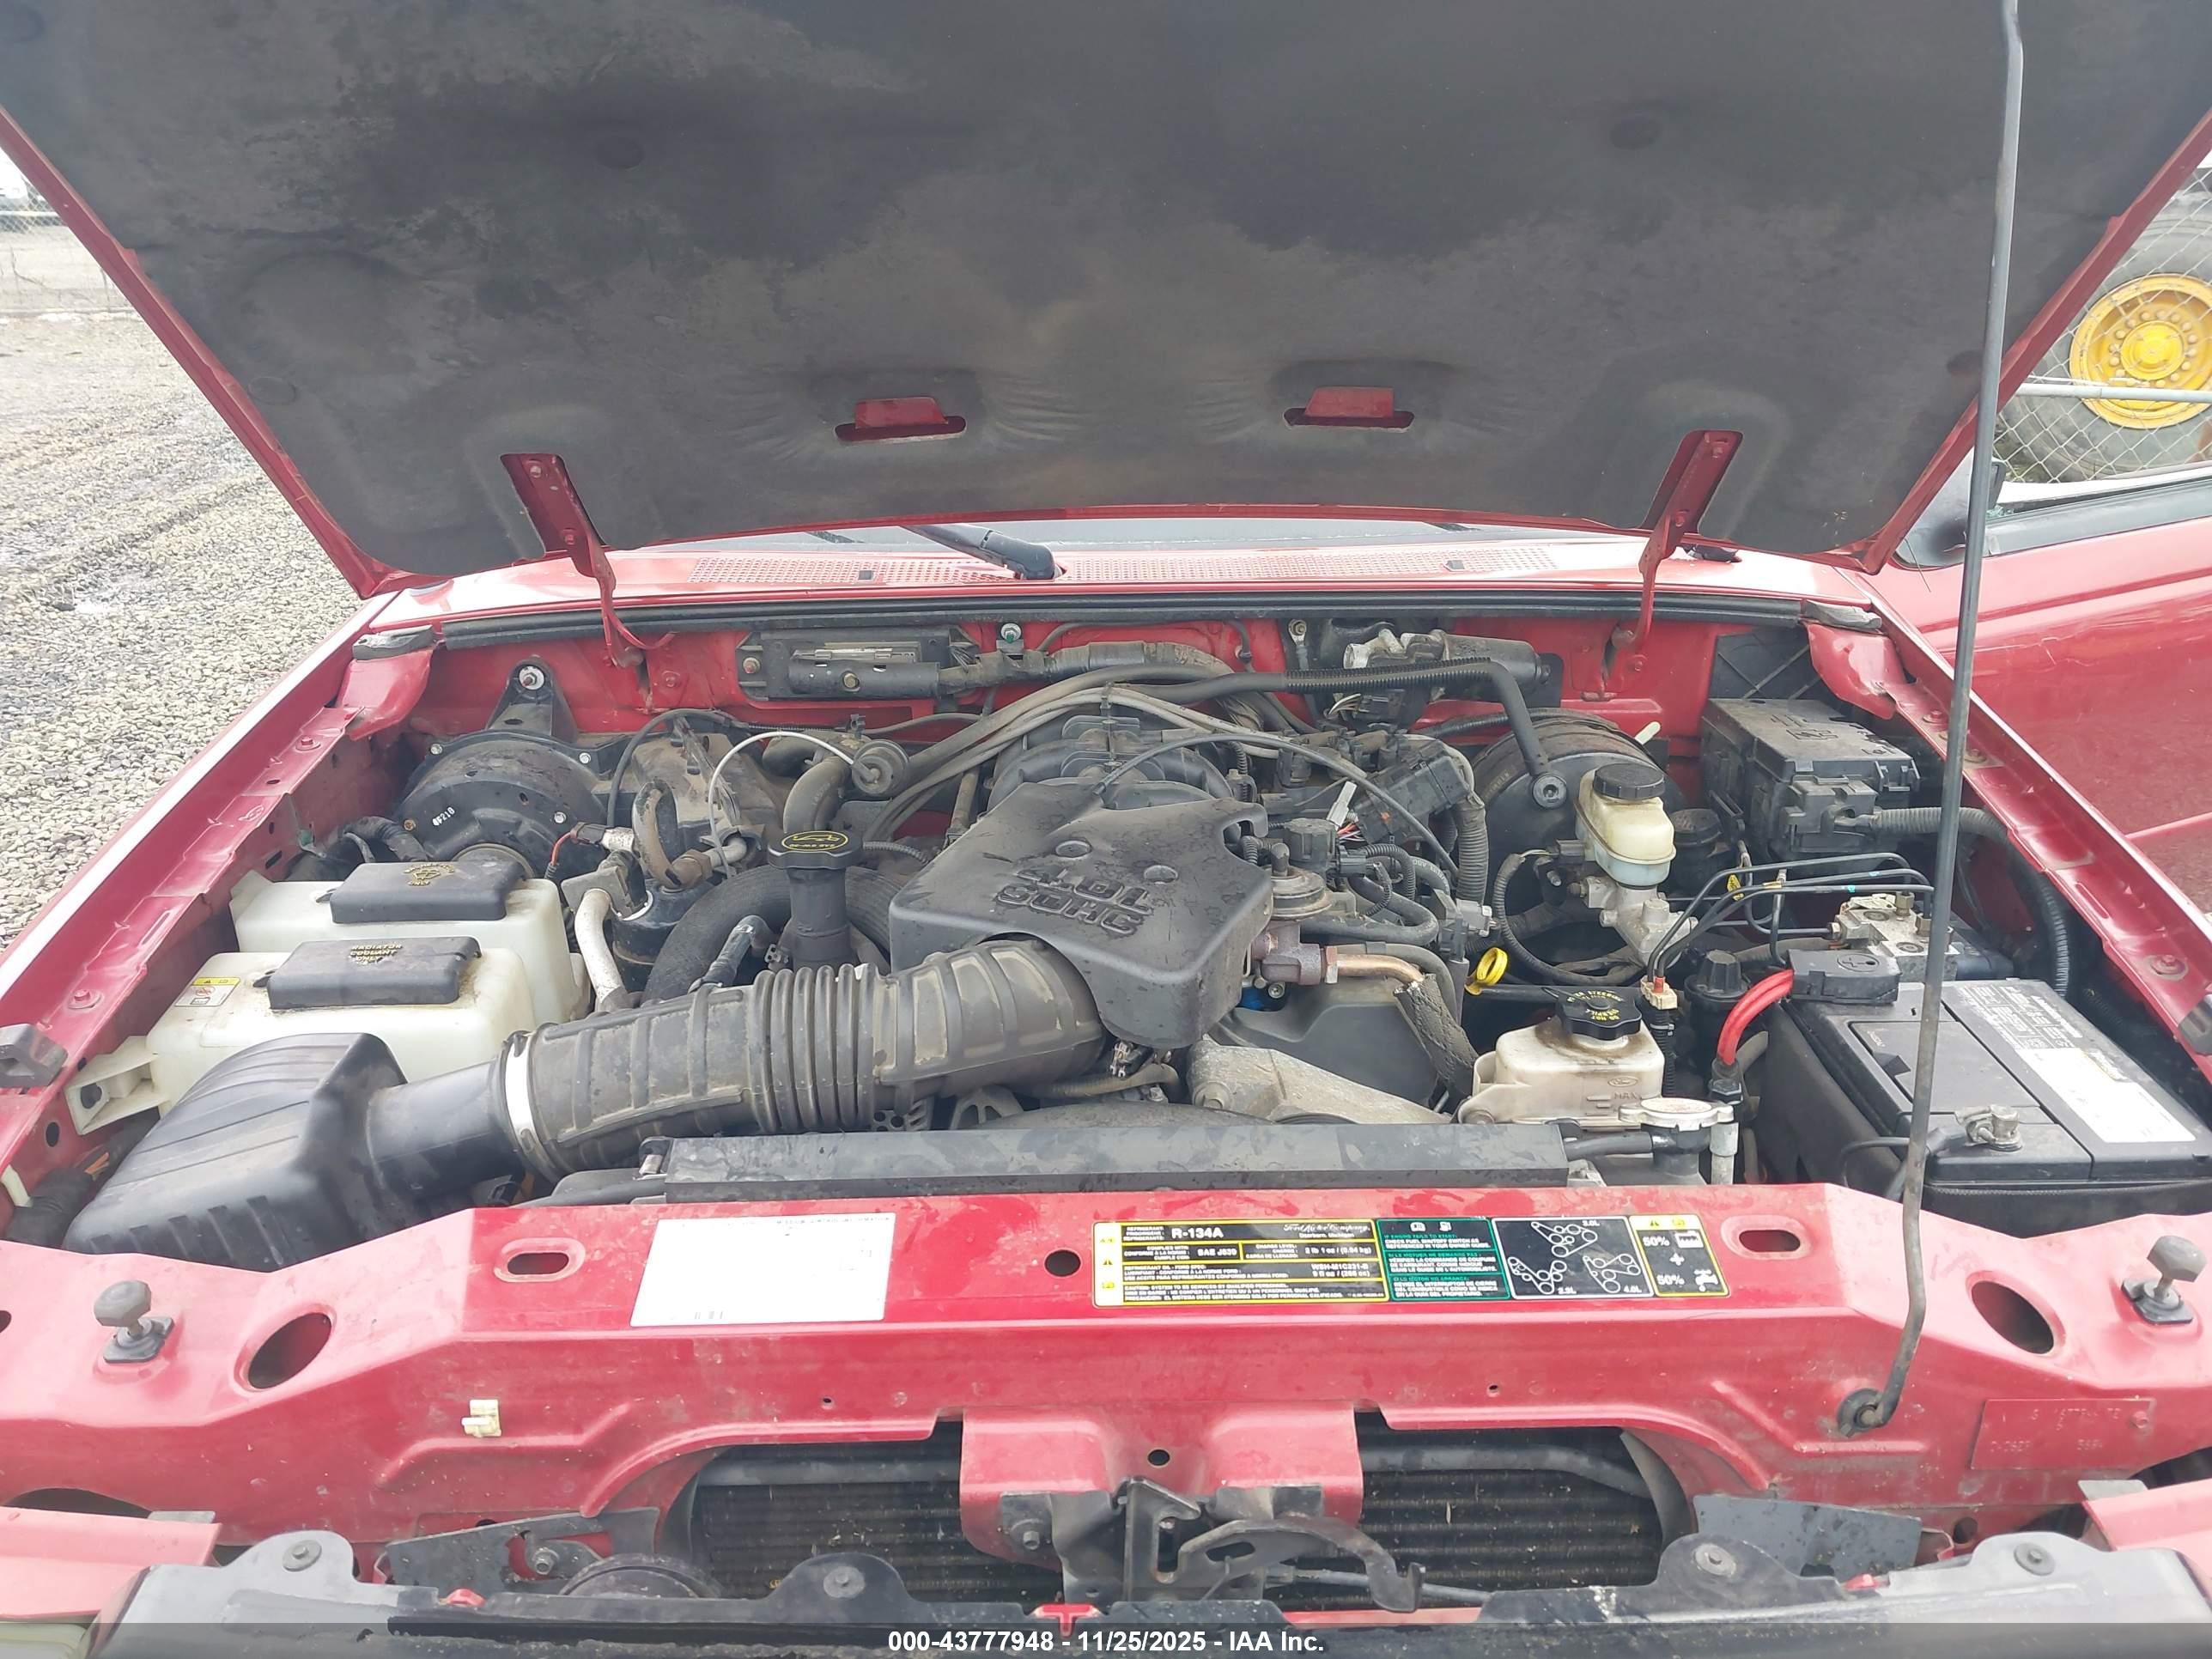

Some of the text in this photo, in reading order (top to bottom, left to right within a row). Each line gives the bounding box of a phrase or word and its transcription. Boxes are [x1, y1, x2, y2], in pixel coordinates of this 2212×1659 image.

[996, 884, 1142, 935] SOHC
[1171, 1227, 1224, 1239] R-134A
[1643, 1236, 1669, 1247] 50%
[1656, 1274, 1685, 1285] 50%
